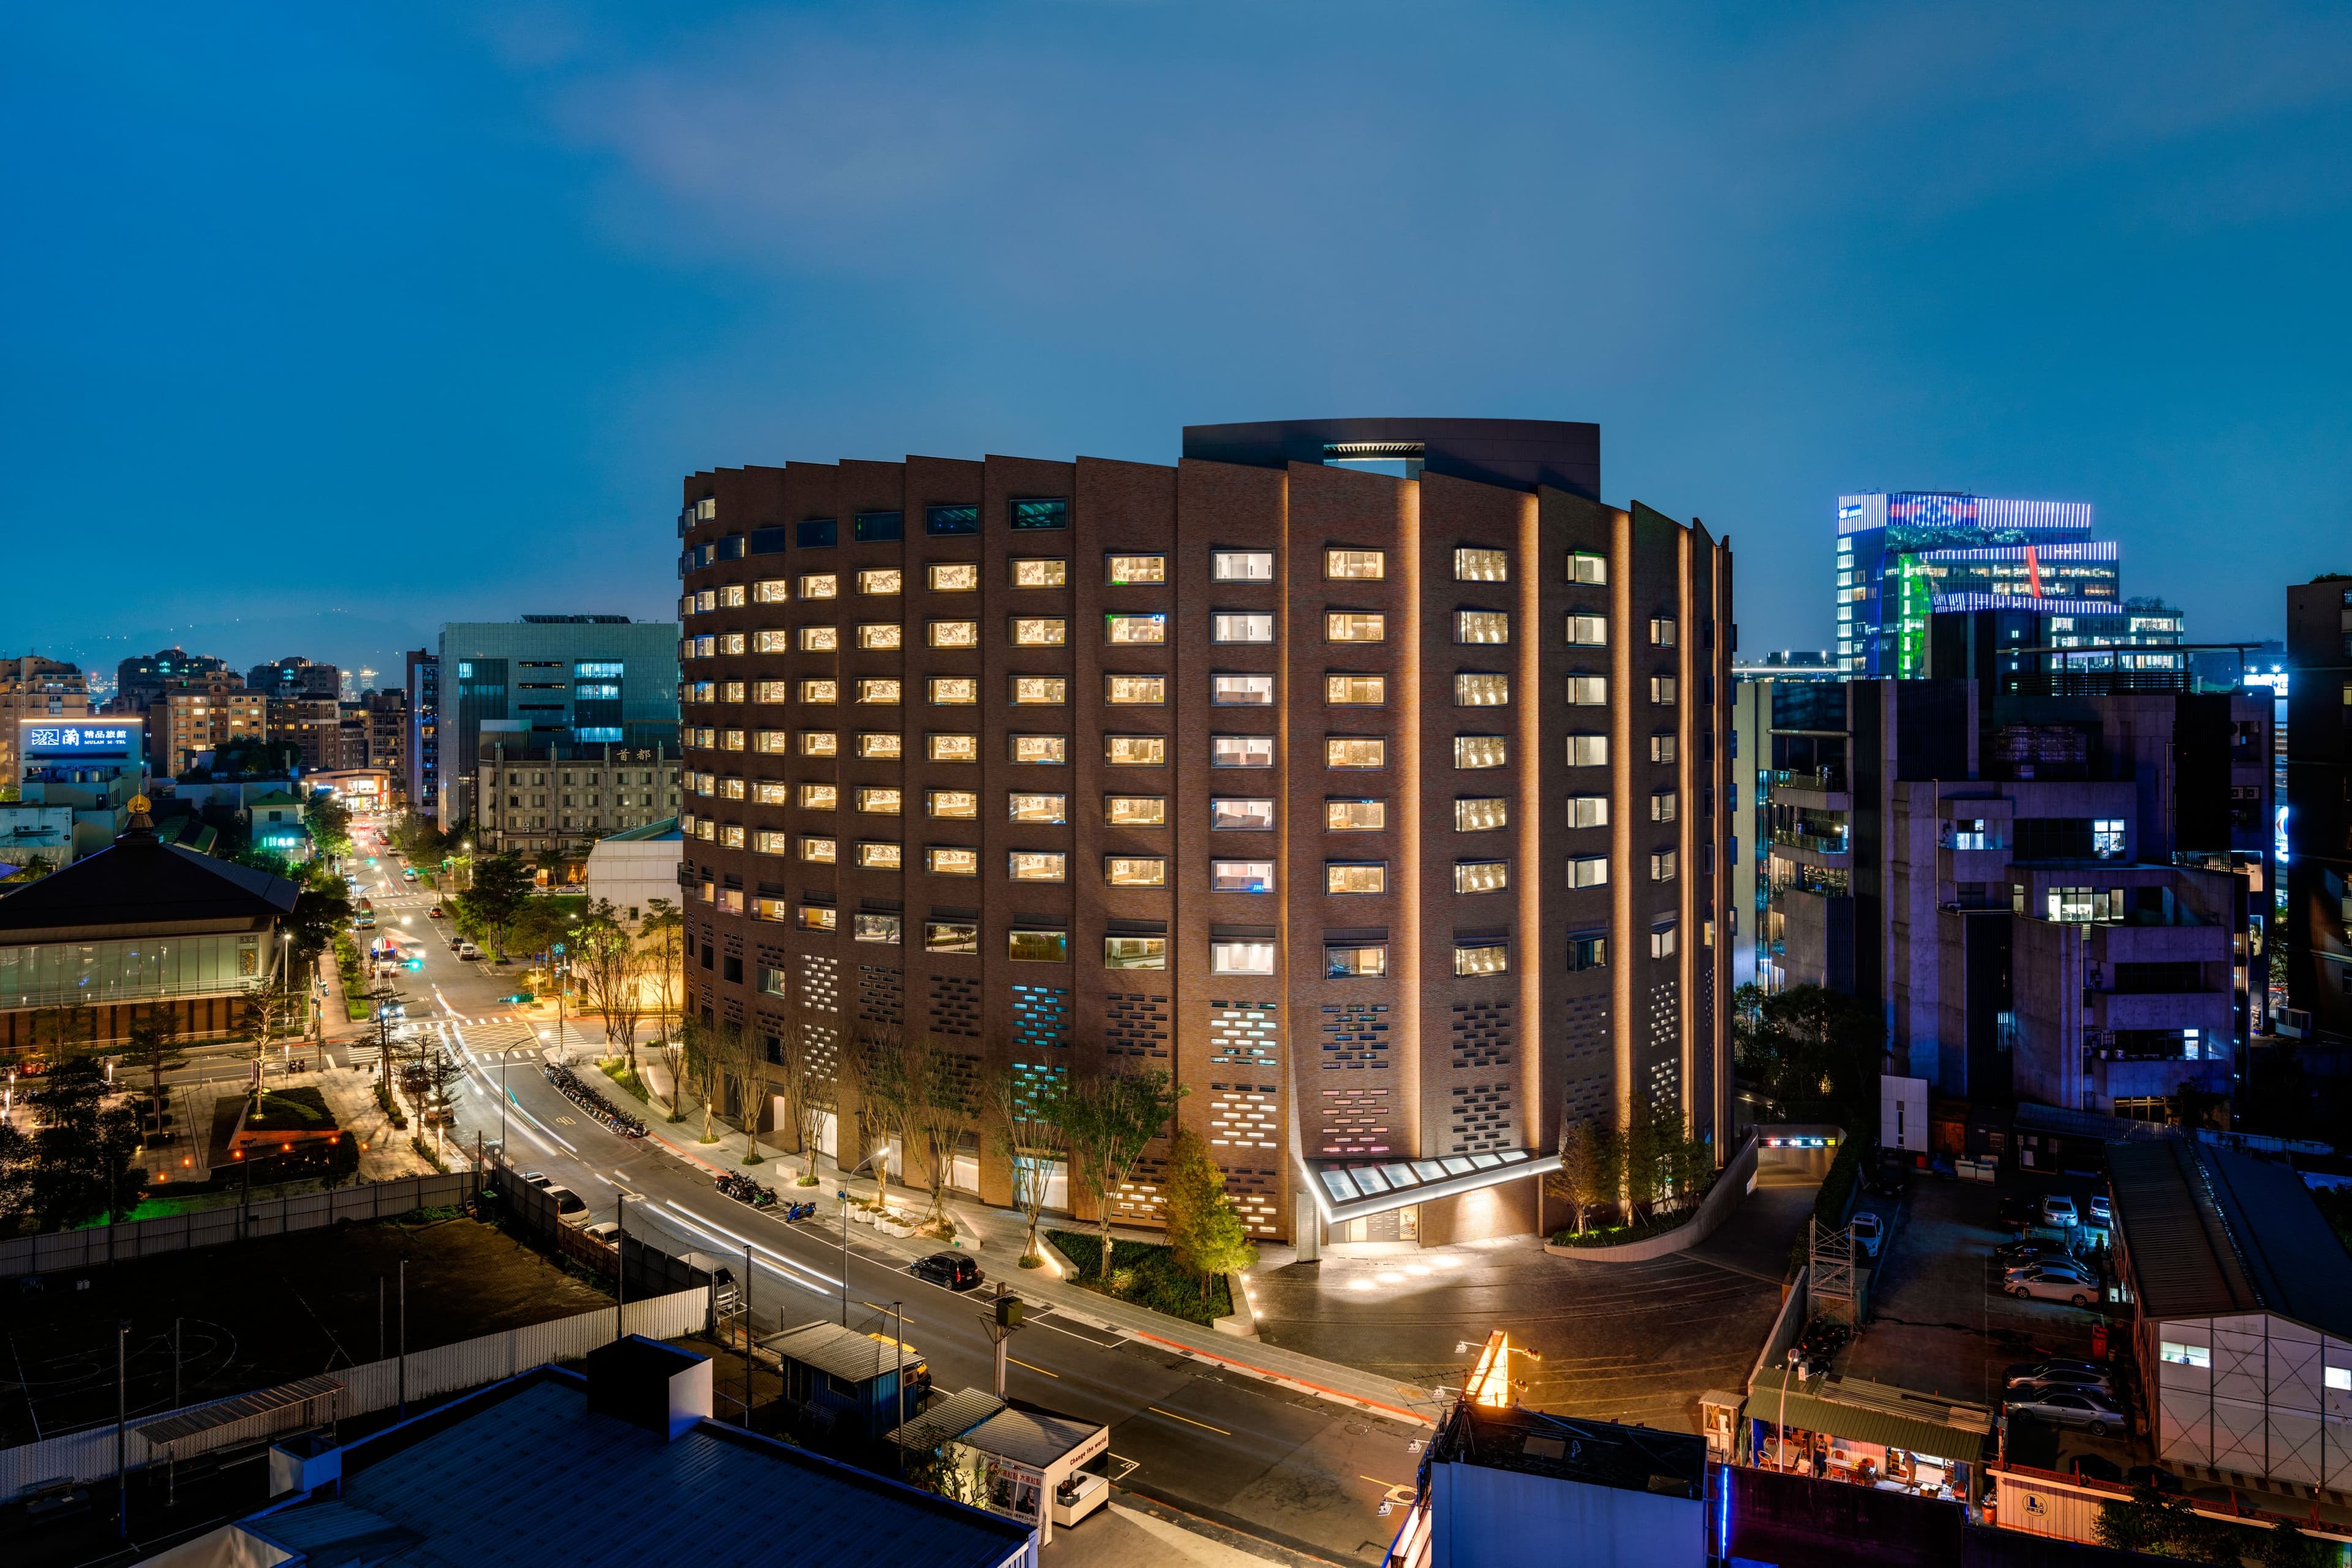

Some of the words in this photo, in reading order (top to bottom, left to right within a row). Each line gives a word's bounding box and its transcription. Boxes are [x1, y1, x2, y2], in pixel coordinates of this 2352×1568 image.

[83, 729, 127, 739] 精品旅館
[616, 748, 651, 761] 首都
[1069, 1452, 1085, 1465] Change
[1095, 1435, 1107, 1448] world
